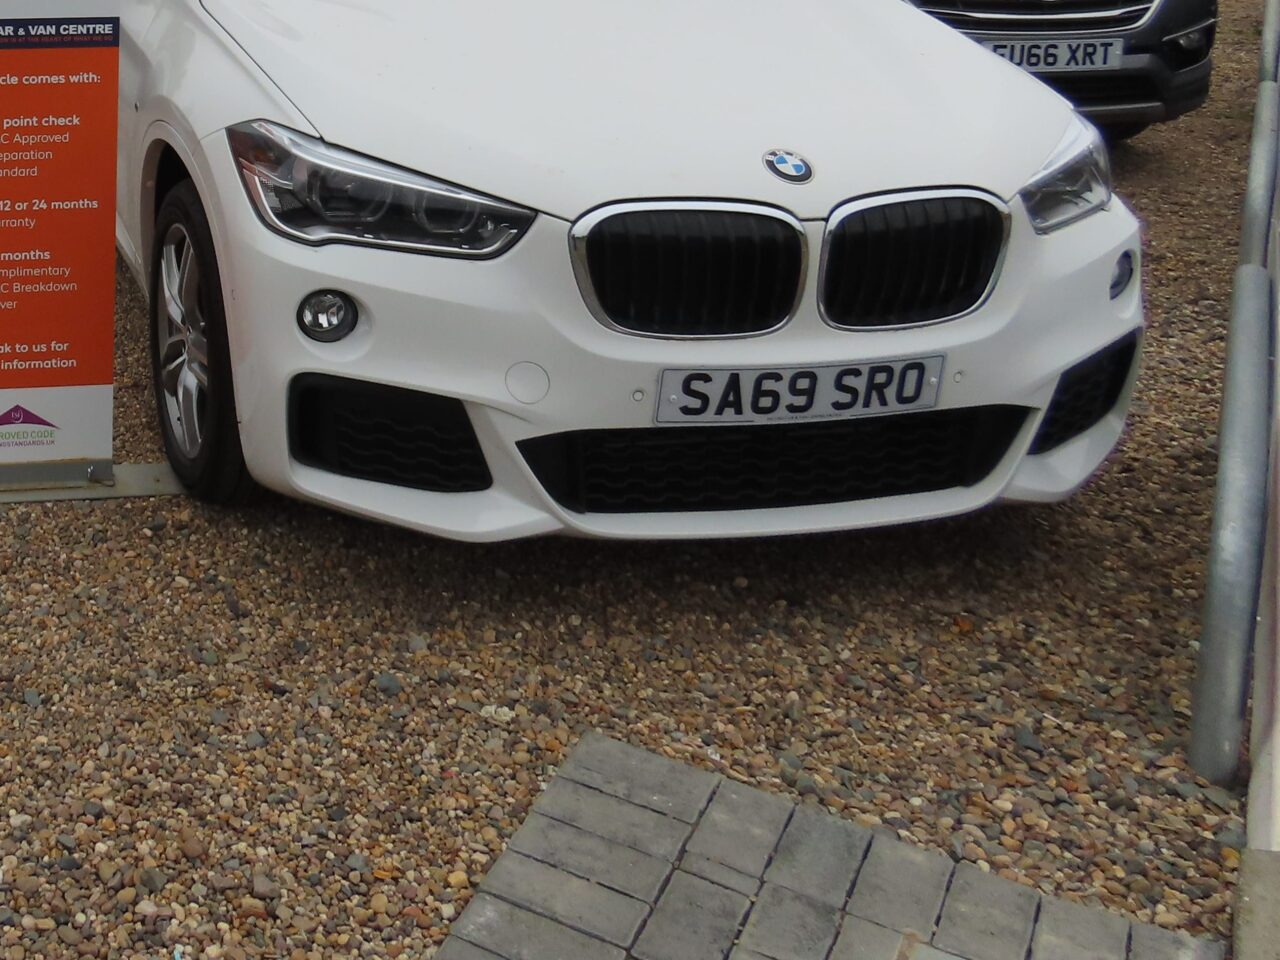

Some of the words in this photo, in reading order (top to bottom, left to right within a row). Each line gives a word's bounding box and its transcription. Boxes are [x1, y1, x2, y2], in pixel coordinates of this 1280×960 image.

[17, 28, 26, 36] &
[28, 25, 56, 36] VAN
[59, 24, 113, 35] CENTRE
[1065, 43, 1113, 66] XRT
[22, 75, 65, 84] comes
[69, 72, 101, 83] with:
[3, 116, 39, 129] point
[42, 115, 80, 126] check
[13, 132, 69, 145] Approved
[15, 202, 29, 211] or
[32, 200, 47, 210] 24
[51, 198, 98, 209] months
[1, 250, 51, 261] months
[13, 282, 77, 293] Breakdown
[15, 343, 29, 353] to
[32, 344, 47, 353] us
[51, 341, 70, 352] for
[0, 357, 77, 370] information
[678, 370, 818, 417] SA69
[830, 361, 926, 411] SRO
[31, 430, 55, 439] CODE
